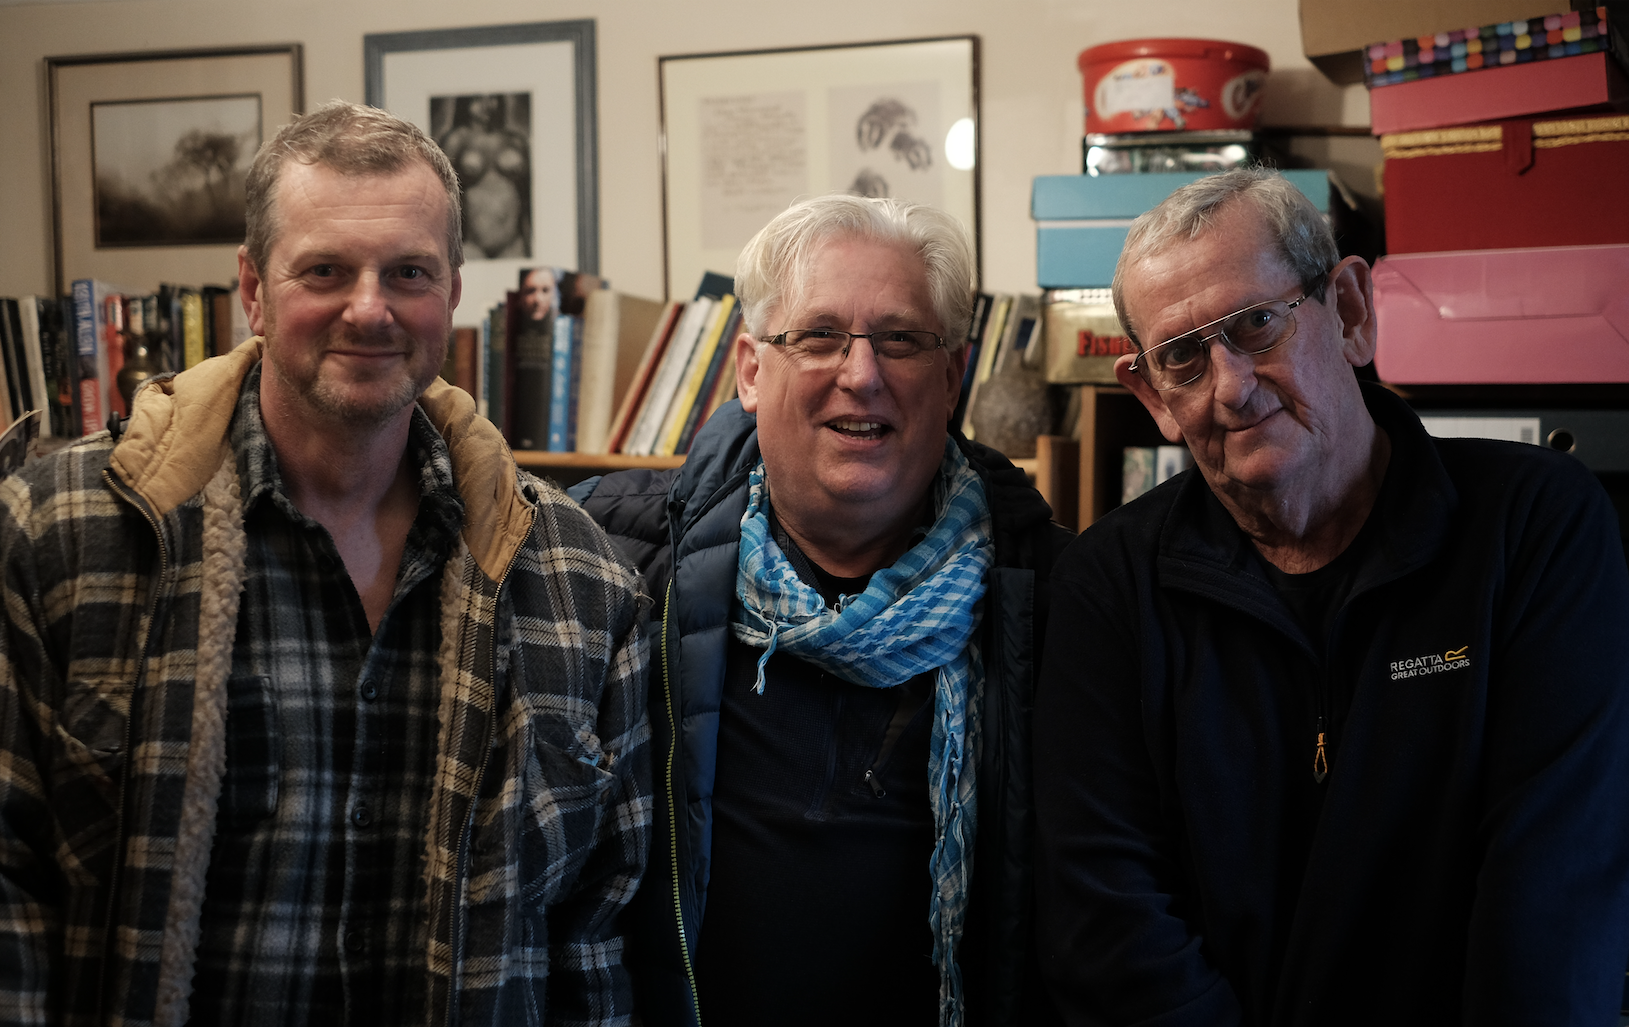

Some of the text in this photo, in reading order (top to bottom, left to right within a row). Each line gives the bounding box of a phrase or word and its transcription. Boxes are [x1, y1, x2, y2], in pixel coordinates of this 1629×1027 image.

[1390, 654, 1443, 672] REGATTA
[1391, 659, 1470, 680] GREAT OUTDOORS
